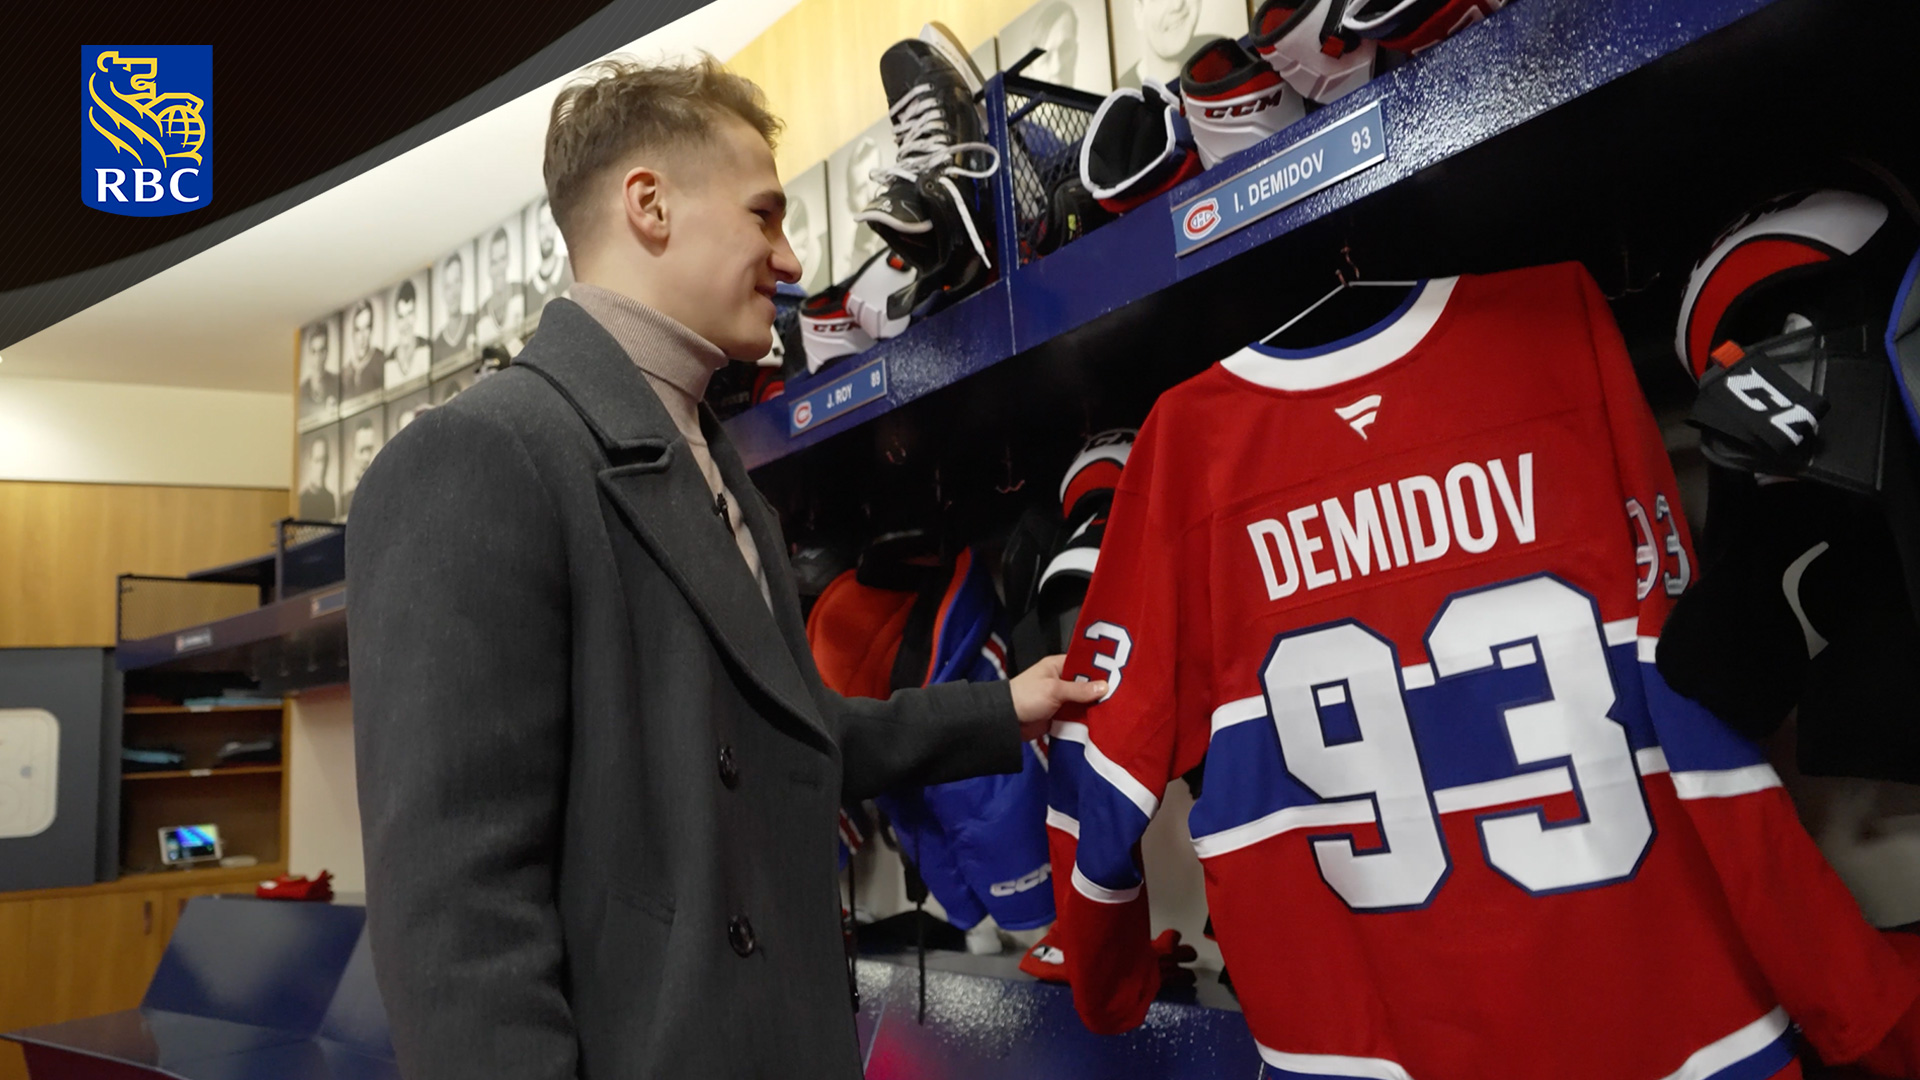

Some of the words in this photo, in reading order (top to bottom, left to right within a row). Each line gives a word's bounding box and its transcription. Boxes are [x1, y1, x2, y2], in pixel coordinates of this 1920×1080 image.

[1204, 89, 1283, 119] CCM
[1234, 192, 1244, 213] I.
[1248, 149, 1324, 206] DEMIDOV
[1351, 126, 1371, 154] 93
[835, 383, 853, 405] ROY
[1726, 366, 1819, 447] CC
[1246, 452, 1536, 601] DEMIDOV
[1259, 571, 1656, 914] 93
